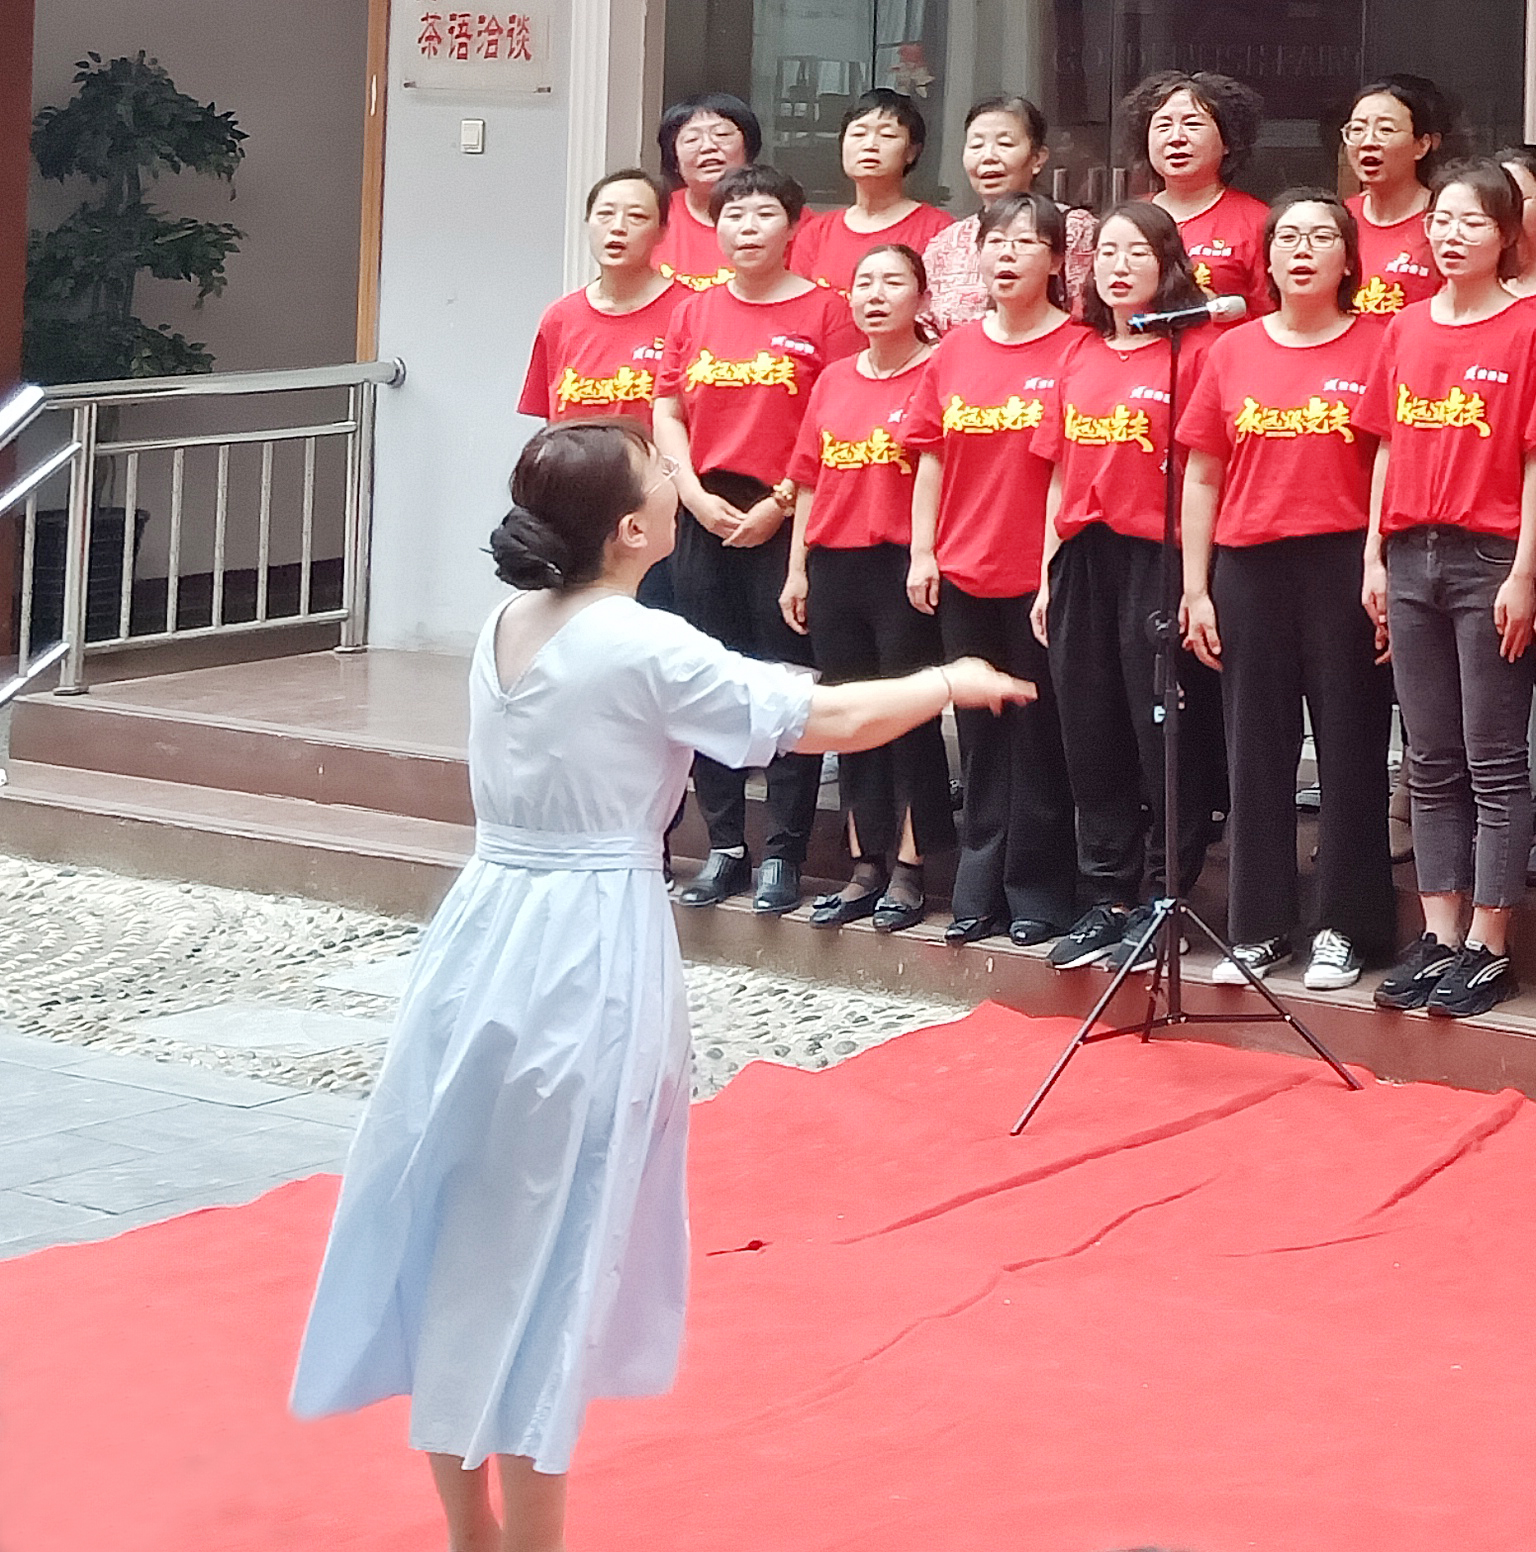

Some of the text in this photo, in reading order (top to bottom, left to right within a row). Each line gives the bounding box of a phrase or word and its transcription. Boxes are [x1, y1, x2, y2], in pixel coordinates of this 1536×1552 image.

[417, 12, 532, 61] 茶语洽谈
[687, 349, 798, 395] 永远跟党走
[1235, 395, 1354, 443] 永远跟党走
